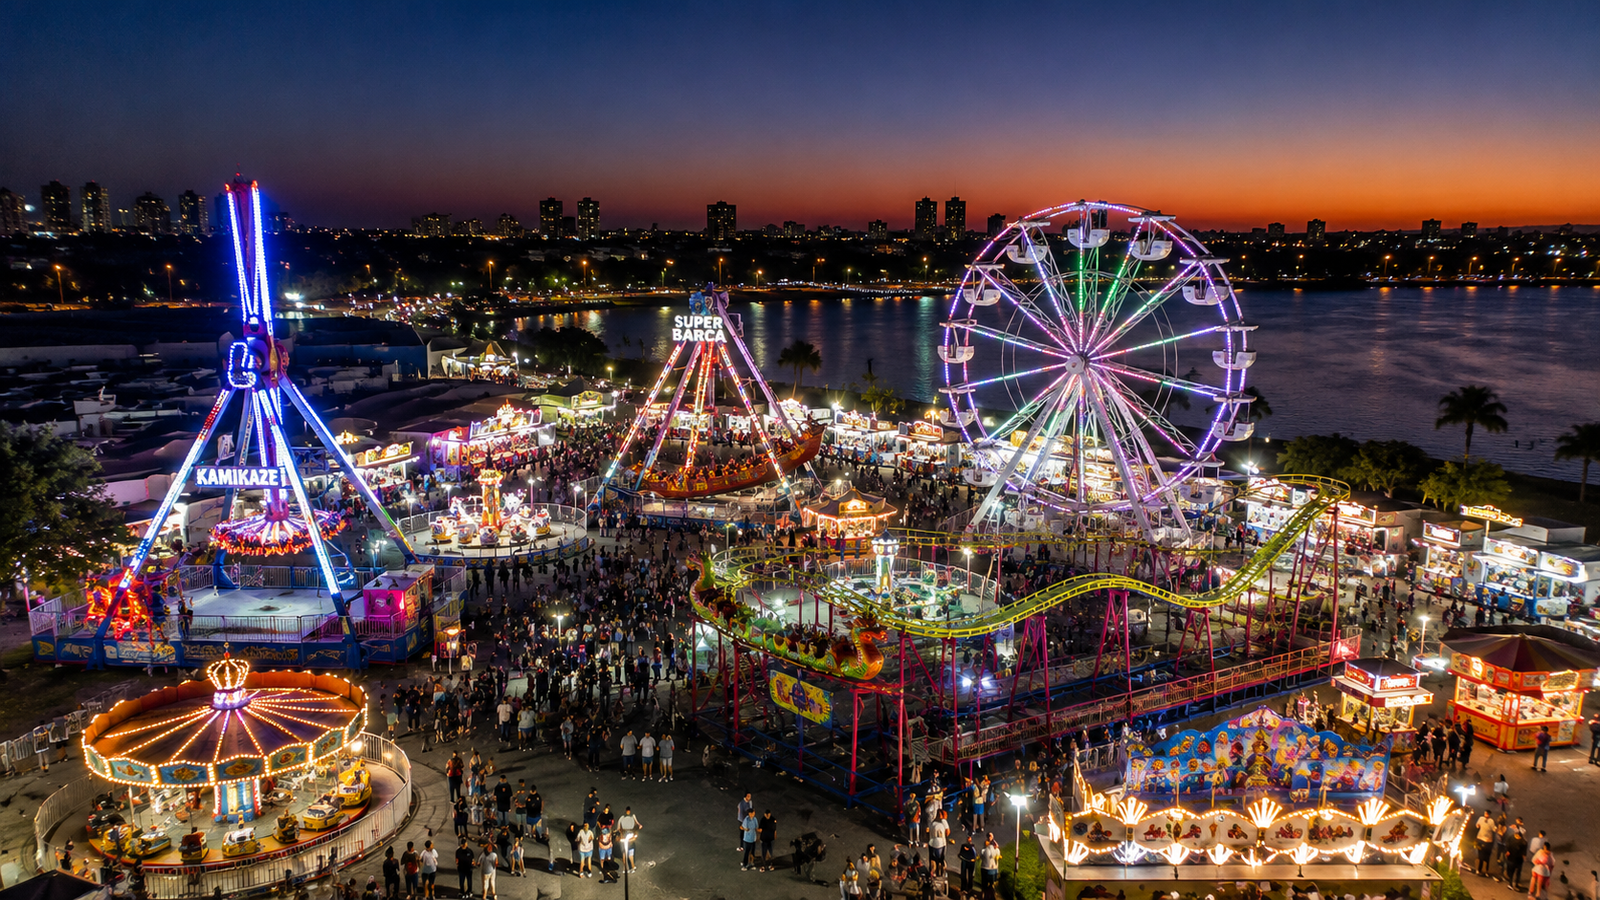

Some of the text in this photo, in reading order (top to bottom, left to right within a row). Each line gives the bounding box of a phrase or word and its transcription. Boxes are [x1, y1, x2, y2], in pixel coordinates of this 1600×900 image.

[674, 315, 723, 329] SUPER
[672, 328, 727, 343] BARCA
[196, 468, 279, 486] KAMIKAZE
